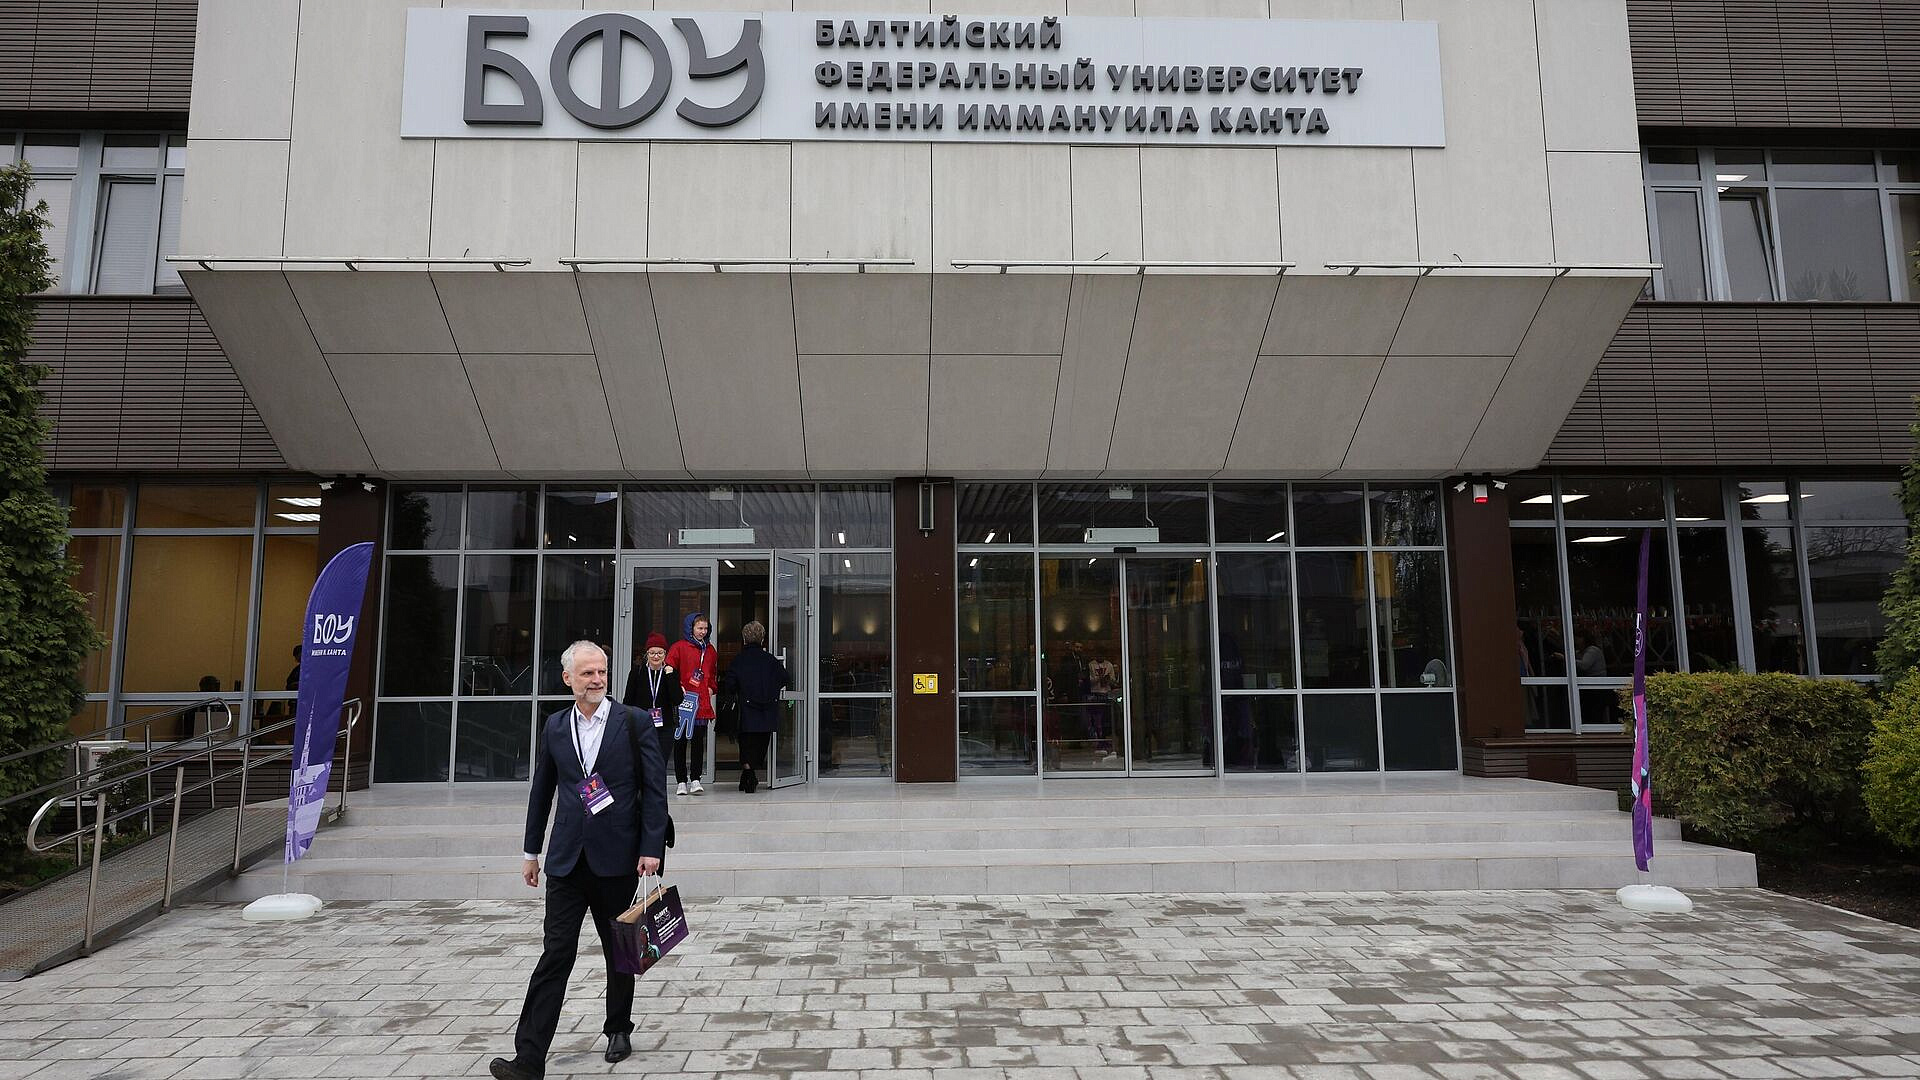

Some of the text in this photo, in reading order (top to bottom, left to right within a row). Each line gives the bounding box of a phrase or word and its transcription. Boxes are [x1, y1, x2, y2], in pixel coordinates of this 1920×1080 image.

[816, 15, 1061, 48] БАЛТИЙСКИЙ
[463, 13, 765, 129] БФУ
[815, 58, 1363, 93] ФЕДЕРАЛЬНЫЙ УНИВЕРСИТЕТ
[815, 102, 1330, 134] ИМЕНИ ИММАНУИЛА КАНТА
[313, 613, 354, 644] БФУ
